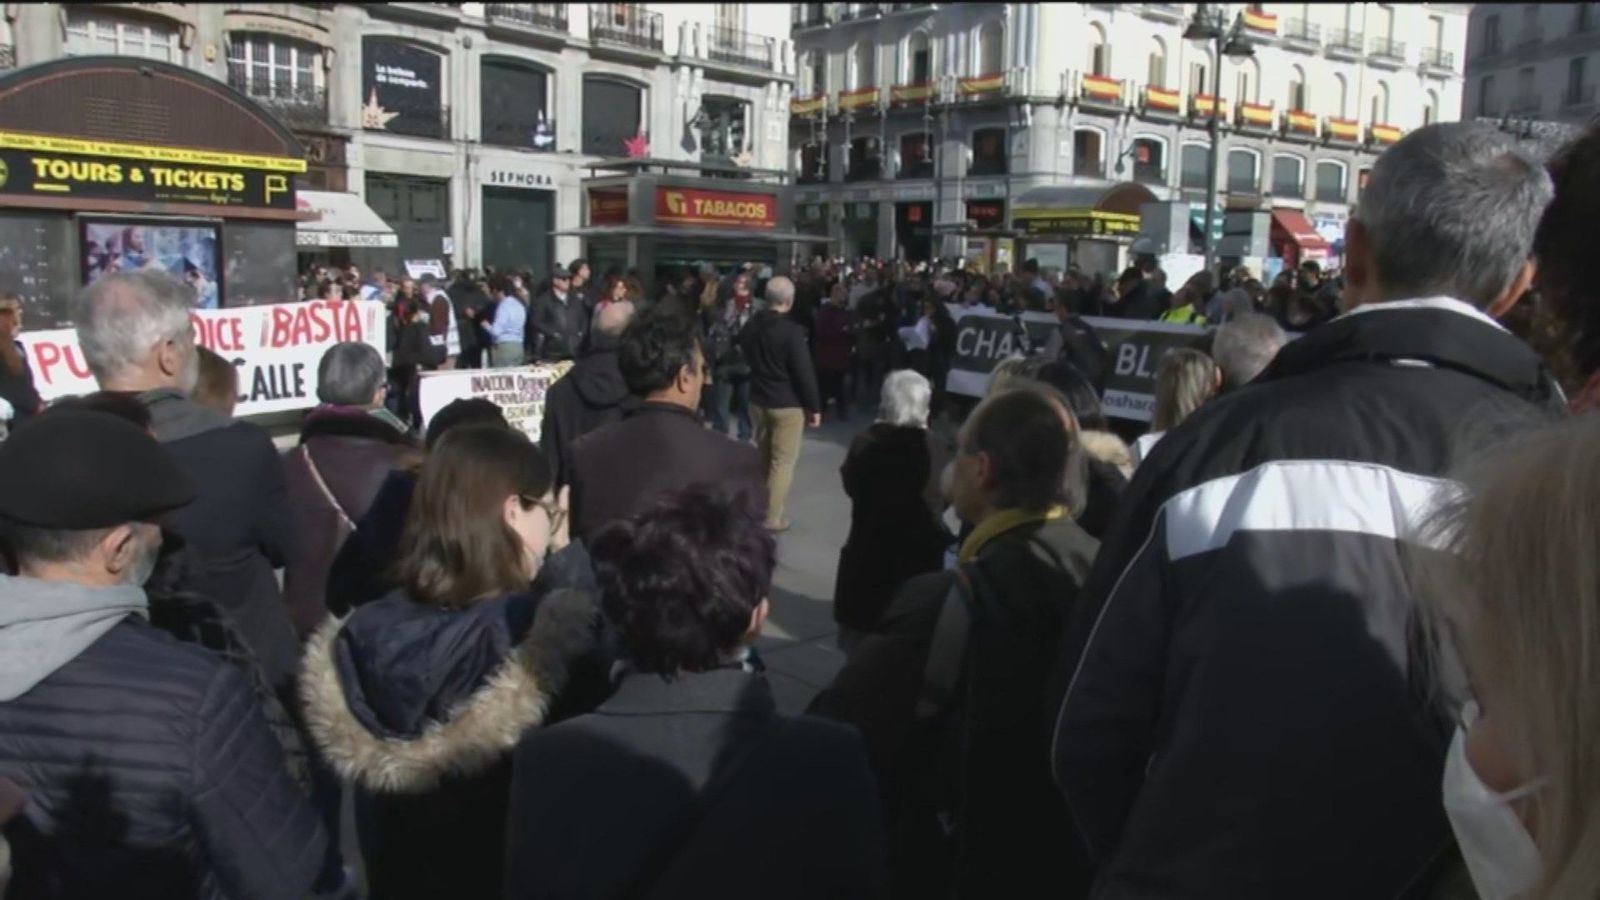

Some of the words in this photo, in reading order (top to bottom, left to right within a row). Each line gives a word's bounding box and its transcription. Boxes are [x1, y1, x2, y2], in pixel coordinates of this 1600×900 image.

[31, 157, 123, 183] TOURS
[129, 167, 144, 183] &
[150, 167, 245, 192] TICKETS
[491, 170, 552, 186] SEPHORA
[694, 198, 767, 218] TABACOS
[1115, 342, 1158, 380] BL
